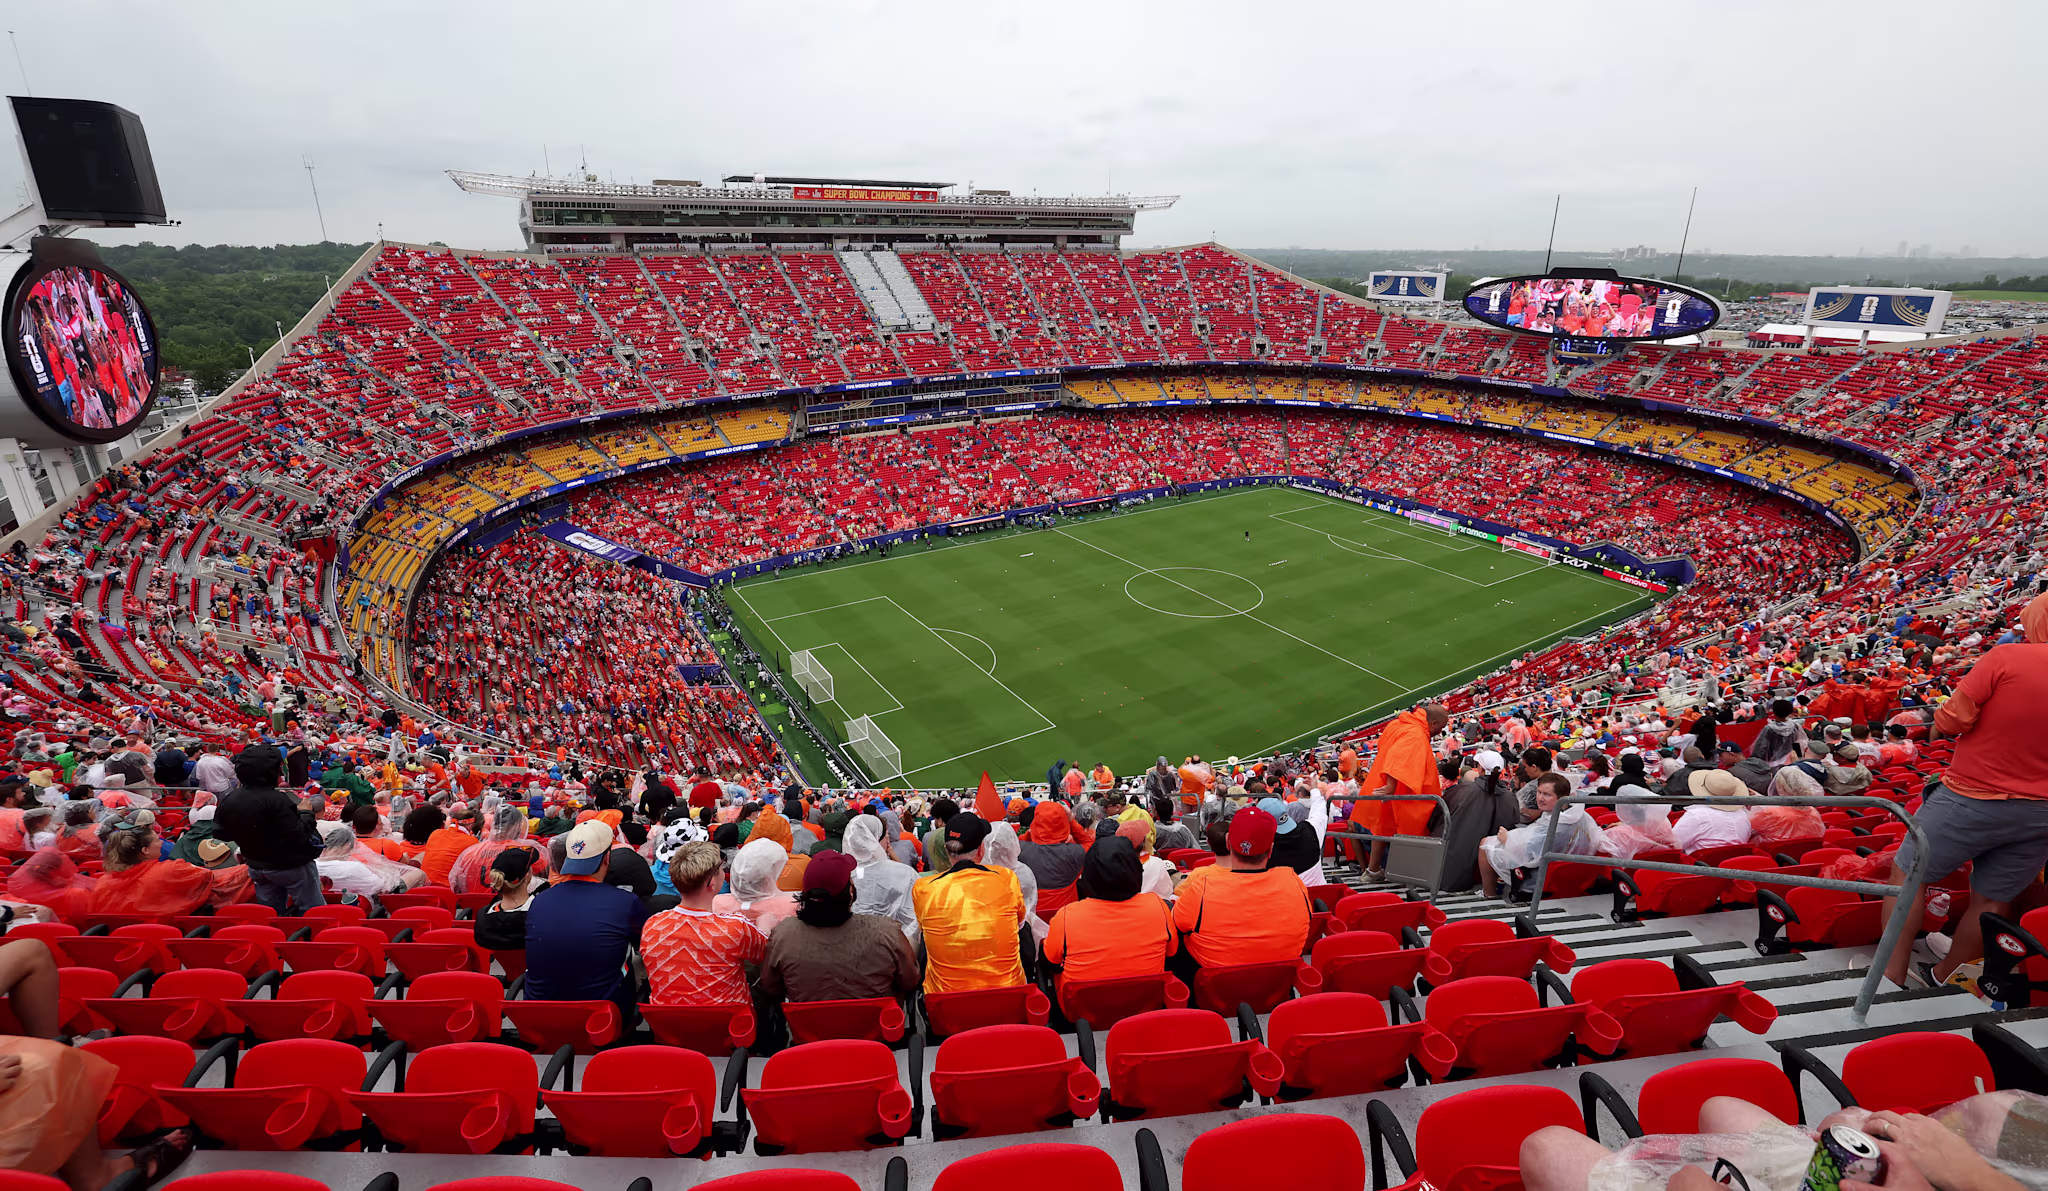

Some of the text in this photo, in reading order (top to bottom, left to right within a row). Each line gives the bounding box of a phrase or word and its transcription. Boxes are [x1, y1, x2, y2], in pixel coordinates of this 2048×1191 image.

[824, 189, 847, 199] SUPER
[849, 190, 869, 200] BOWL
[871, 191, 911, 200] CHAMPIONS
[1686, 408, 1742, 422] KANSAS CITY
[716, 447, 732, 455] WORLD
[742, 443, 758, 451] 2026
[392, 465, 424, 488] KANSAS CITY
[1328, 491, 1363, 504] QATAR AIRWAYS
[1378, 502, 1390, 512] VISA
[1458, 526, 1488, 540] aramco
[1620, 574, 1648, 588] Lenovo
[1759, 943, 1768, 954] 39
[1984, 982, 1999, 995] 40
